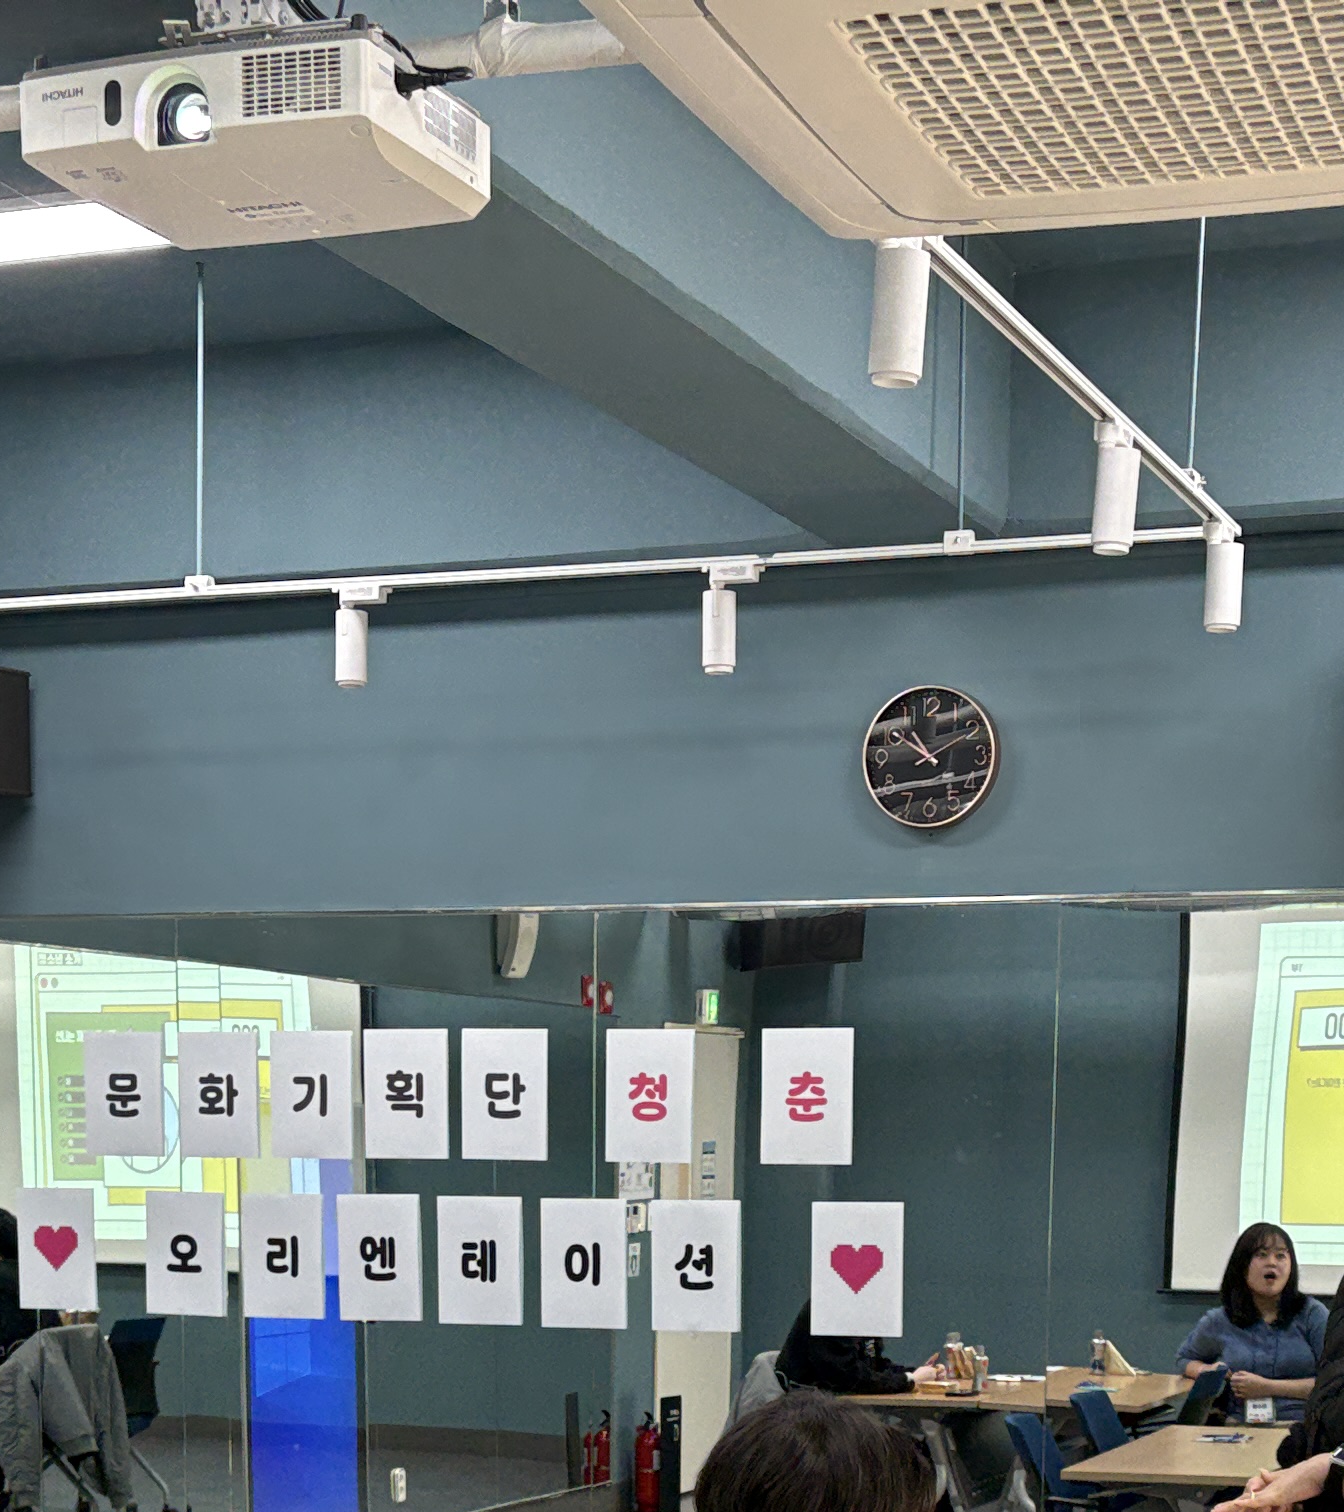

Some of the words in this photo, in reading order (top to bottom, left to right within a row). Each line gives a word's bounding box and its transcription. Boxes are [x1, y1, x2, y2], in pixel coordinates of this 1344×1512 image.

[41, 85, 85, 103] HITACHI
[923, 696, 940, 717] 12
[966, 720, 980, 740] 2
[875, 749, 888, 769] 9
[974, 745, 987, 765] 3
[885, 774, 895, 794] 8
[964, 771, 976, 790] 4
[901, 792, 913, 812] 7
[923, 797, 937, 817] 6
[947, 789, 960, 811] 5
[106, 1069, 527, 1121] 문화기획단
[628, 1070, 828, 1122] 청춘
[166, 1233, 715, 1291] 오리엔테이션
